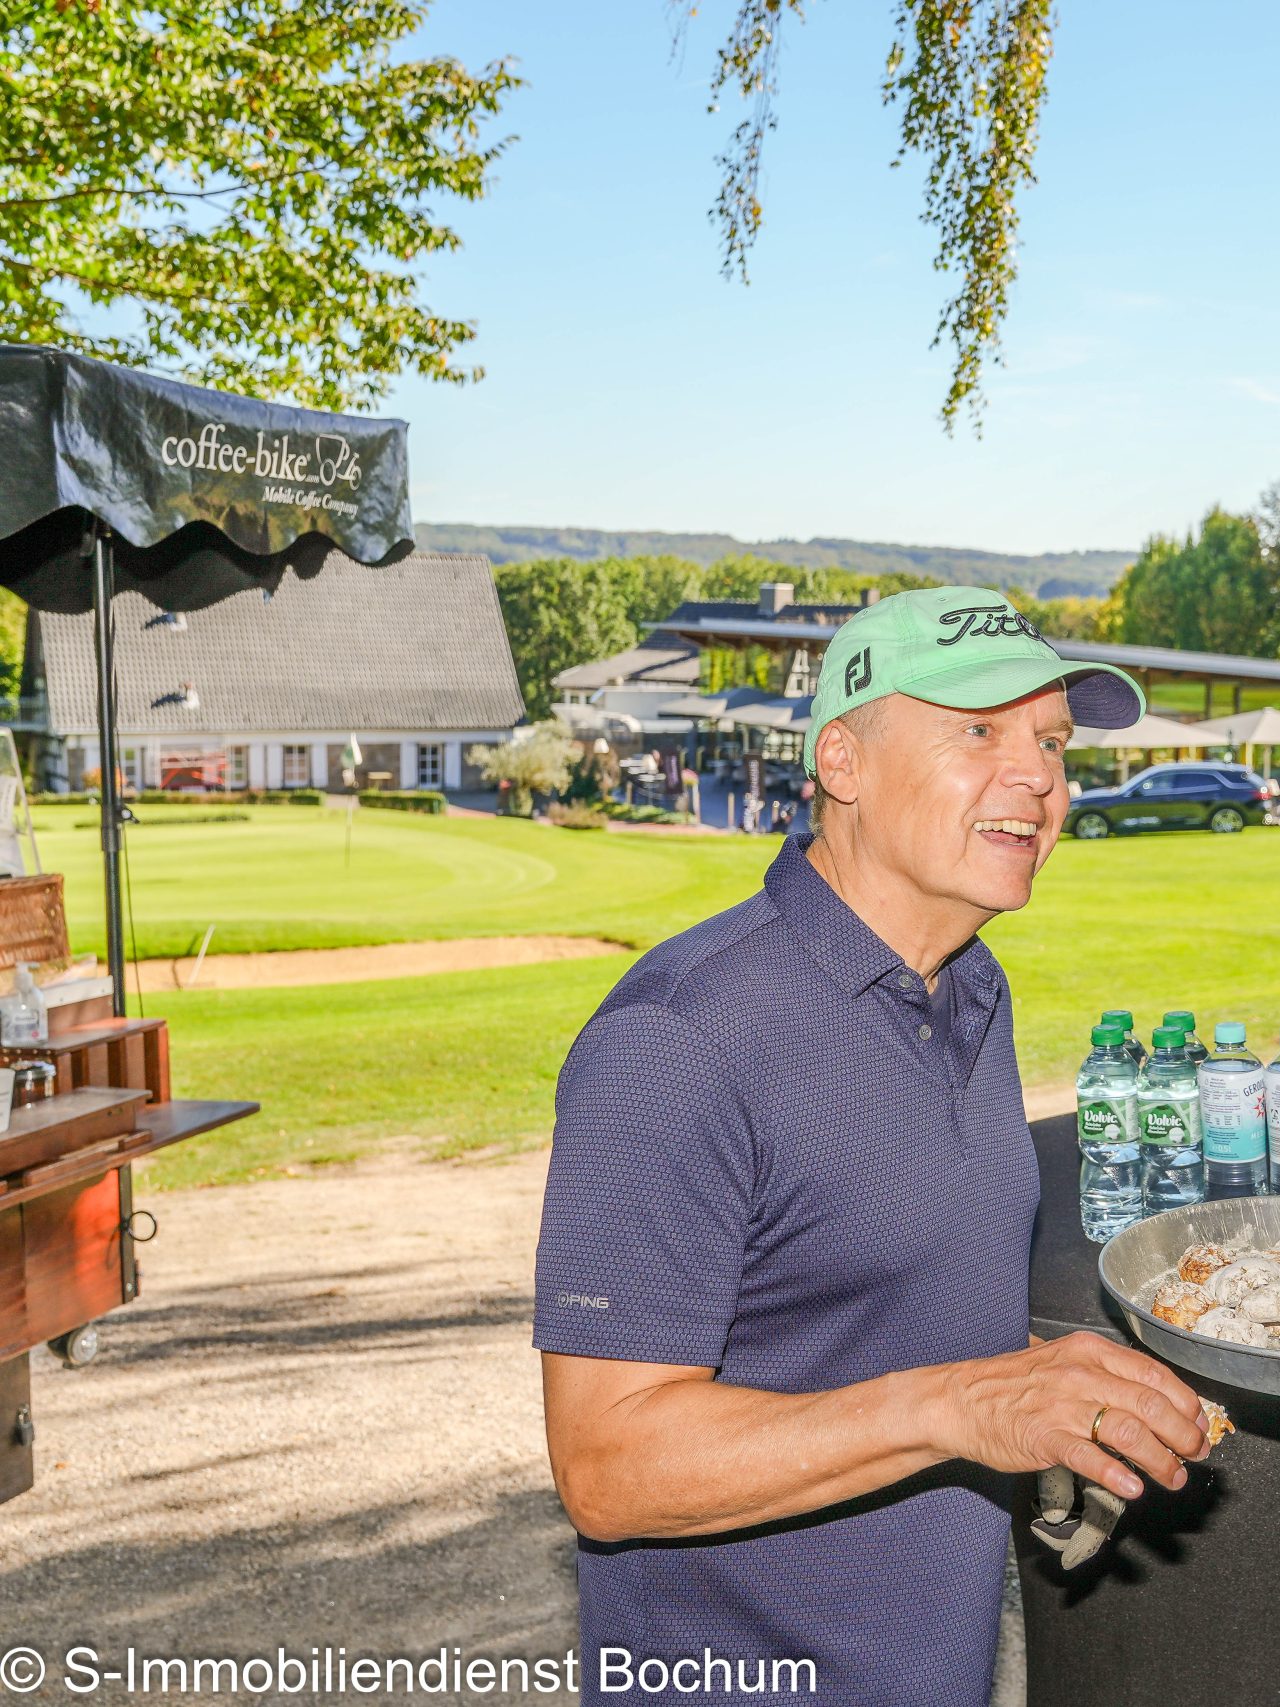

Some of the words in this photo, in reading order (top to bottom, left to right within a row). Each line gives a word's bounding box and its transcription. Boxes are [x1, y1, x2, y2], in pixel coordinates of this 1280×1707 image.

[261, 485, 295, 504] Mobile
[295, 489, 322, 511] Coffee
[322, 493, 359, 520] Company
[1084, 1110, 1118, 1124] Volvic
[1147, 1113, 1182, 1127] Volvic
[570, 1295, 609, 1309] PING
